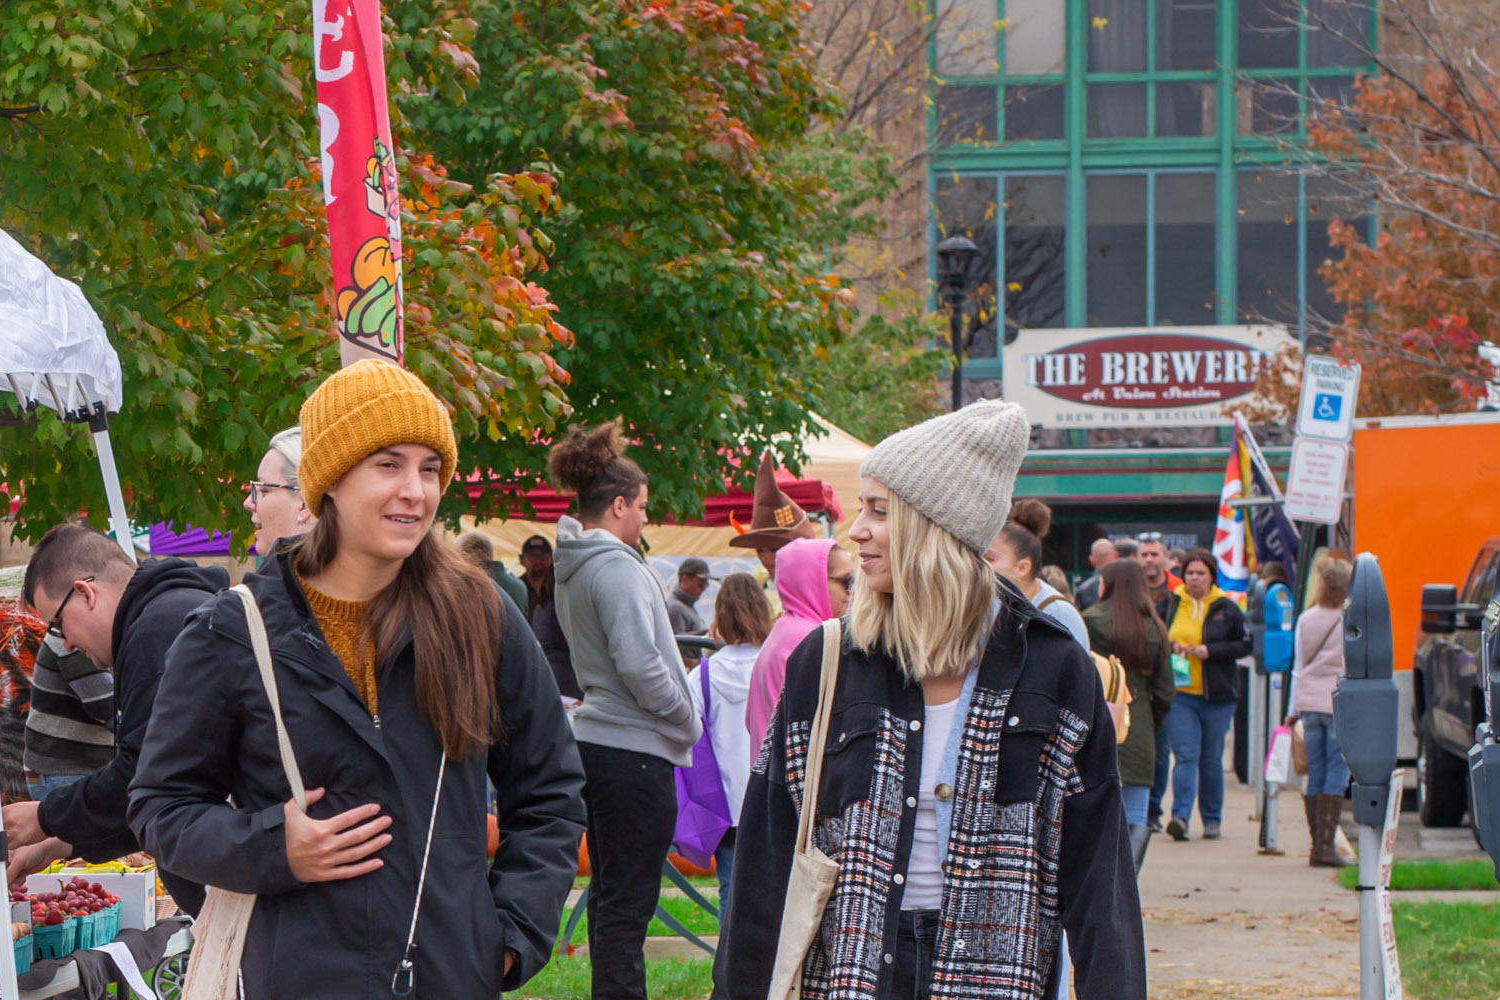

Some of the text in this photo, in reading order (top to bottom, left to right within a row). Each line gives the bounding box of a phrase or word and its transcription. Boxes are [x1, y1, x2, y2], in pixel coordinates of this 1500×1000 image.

[1022, 349, 1276, 387] THE BREWERI
[1056, 410, 1218, 423] BREW PUB & RESTAUR
